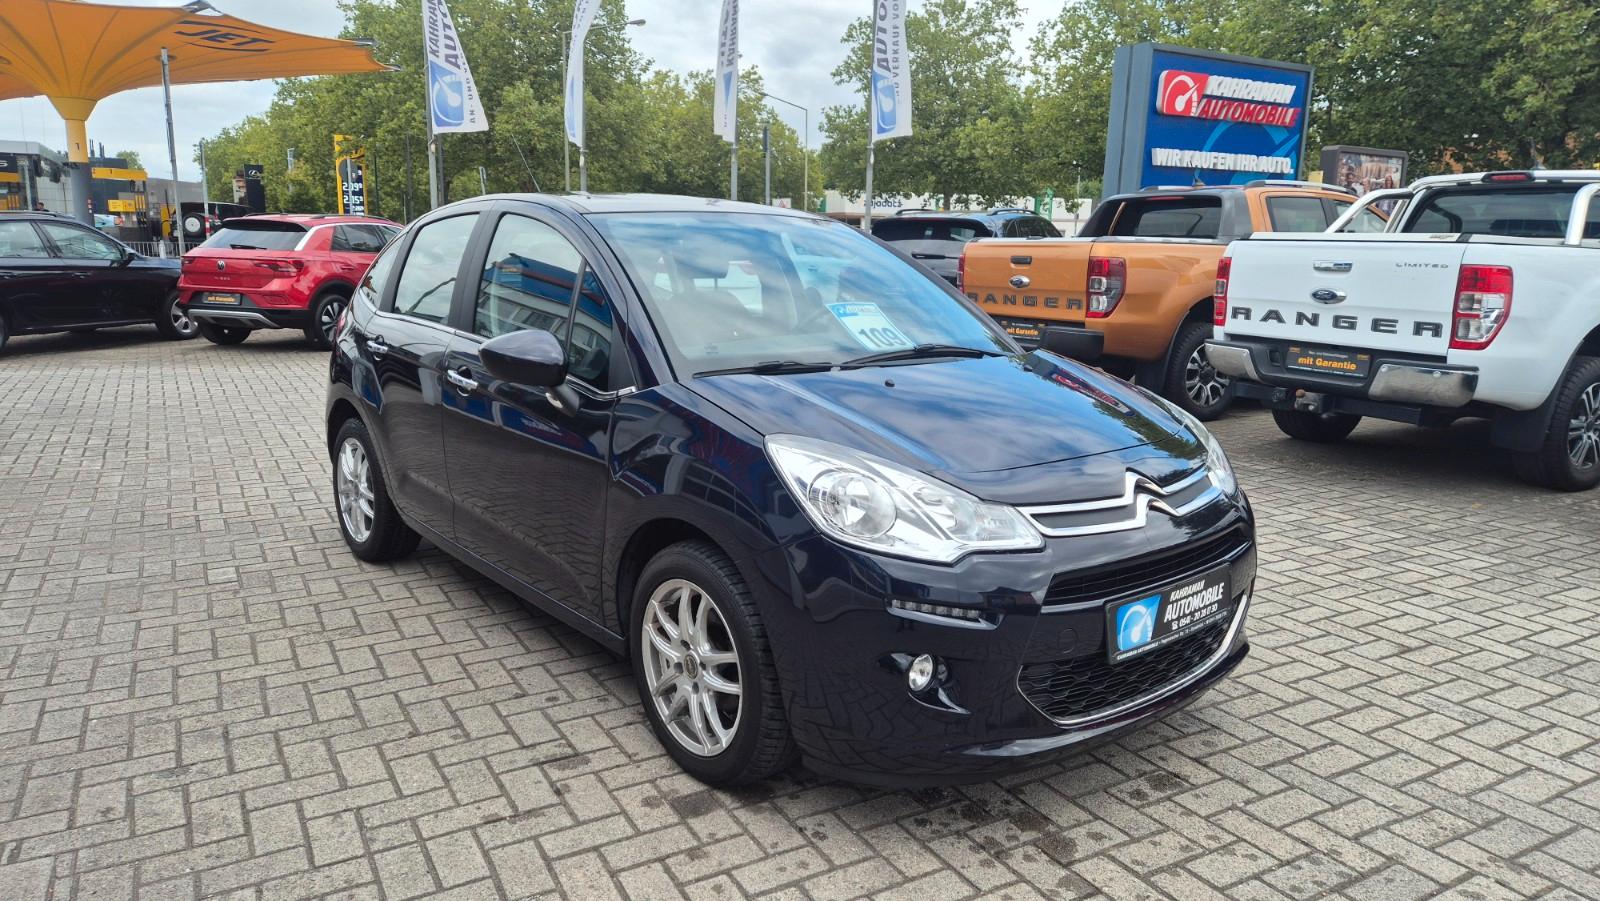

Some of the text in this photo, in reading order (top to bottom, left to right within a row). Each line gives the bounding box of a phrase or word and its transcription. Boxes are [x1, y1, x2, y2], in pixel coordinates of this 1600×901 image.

[174, 29, 275, 46] JET
[876, 0, 892, 73] AUTO
[892, 25, 900, 78] VERKAUF
[1205, 75, 1296, 104] KAHRAMAN
[1199, 98, 1301, 127] AUTOMOBILE
[1153, 148, 1294, 174] WIR KAUFEN IHR AUTO.
[967, 292, 1083, 310] RANGER
[1231, 306, 1444, 338] RANGER
[859, 327, 907, 348] 109
[1298, 357, 1357, 370] mit Garantie
[1164, 582, 1225, 623] AUTOMOBILE
[1170, 580, 1205, 602] KAHRAMAN
